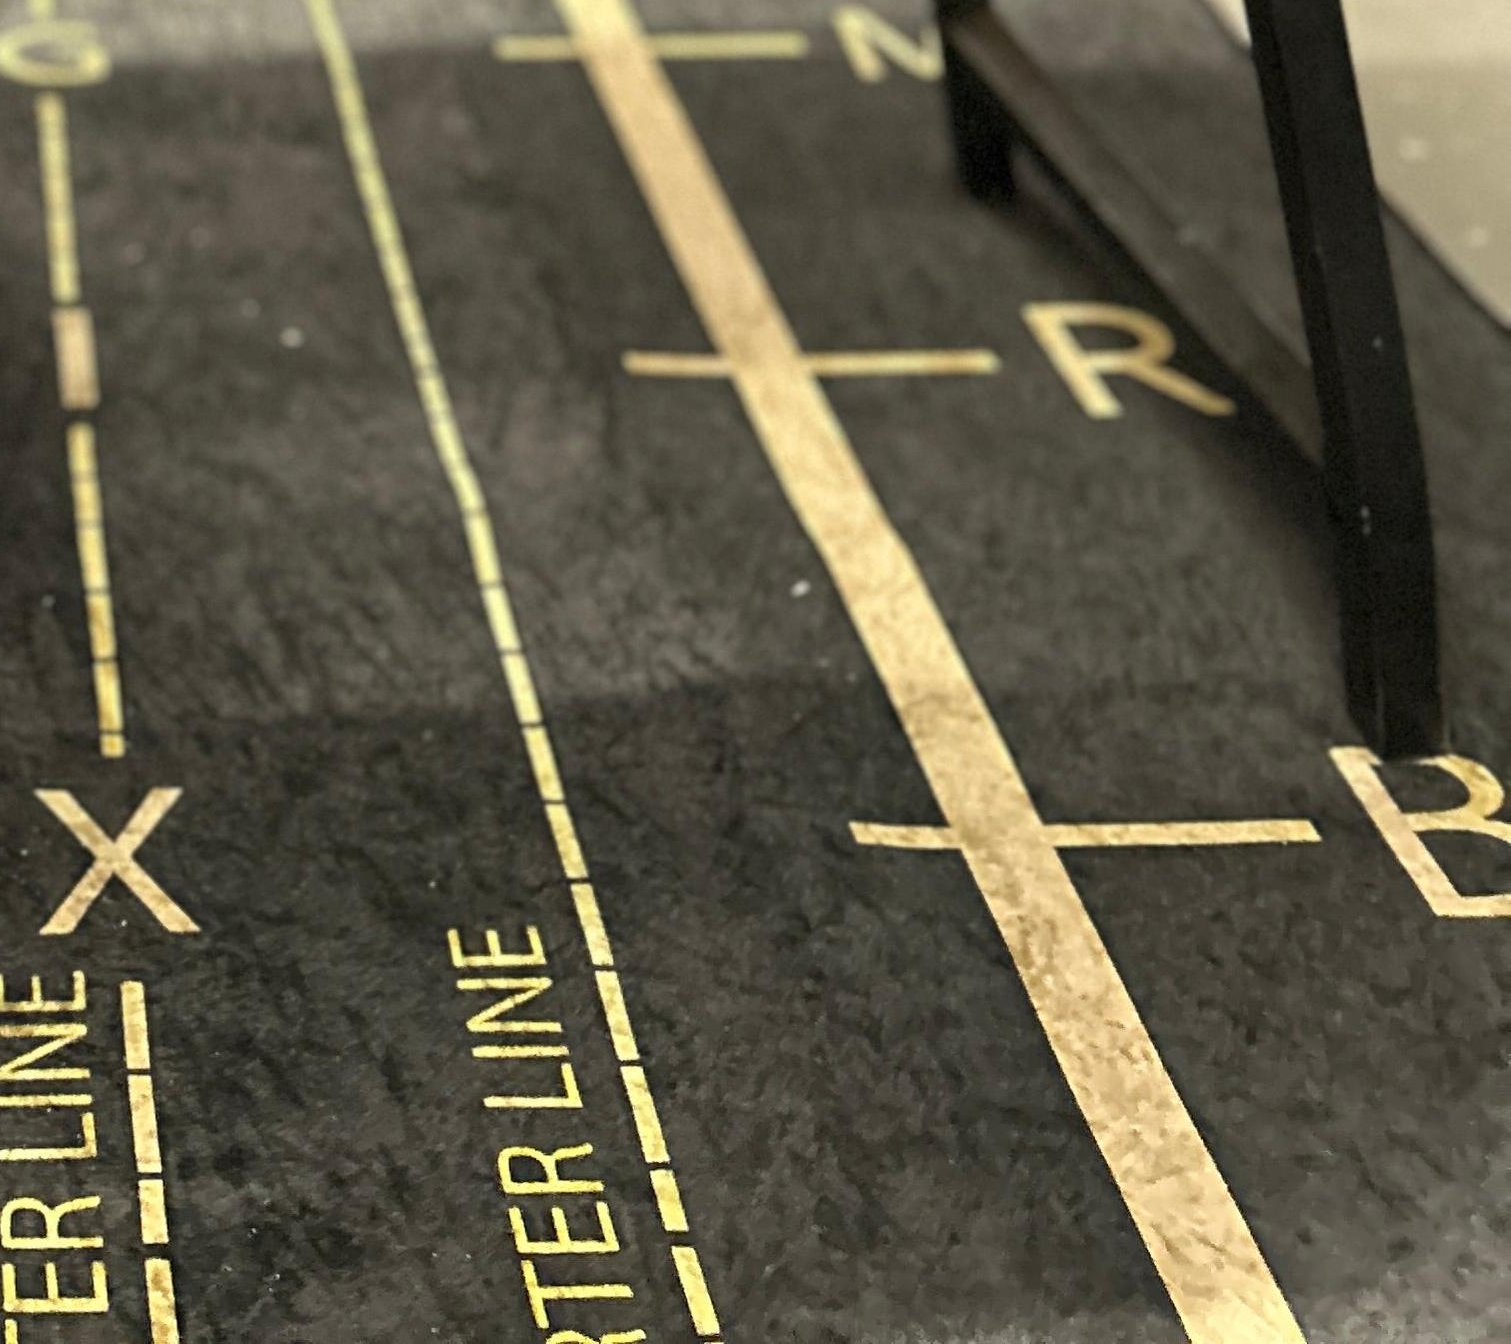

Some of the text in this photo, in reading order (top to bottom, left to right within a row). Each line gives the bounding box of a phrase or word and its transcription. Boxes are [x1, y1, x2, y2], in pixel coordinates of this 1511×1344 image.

[1021, 301, 1236, 418] R
[34, 786, 201, 936] X
[1328, 745, 1511, 917] B
[447, 924, 584, 1109] LINE
